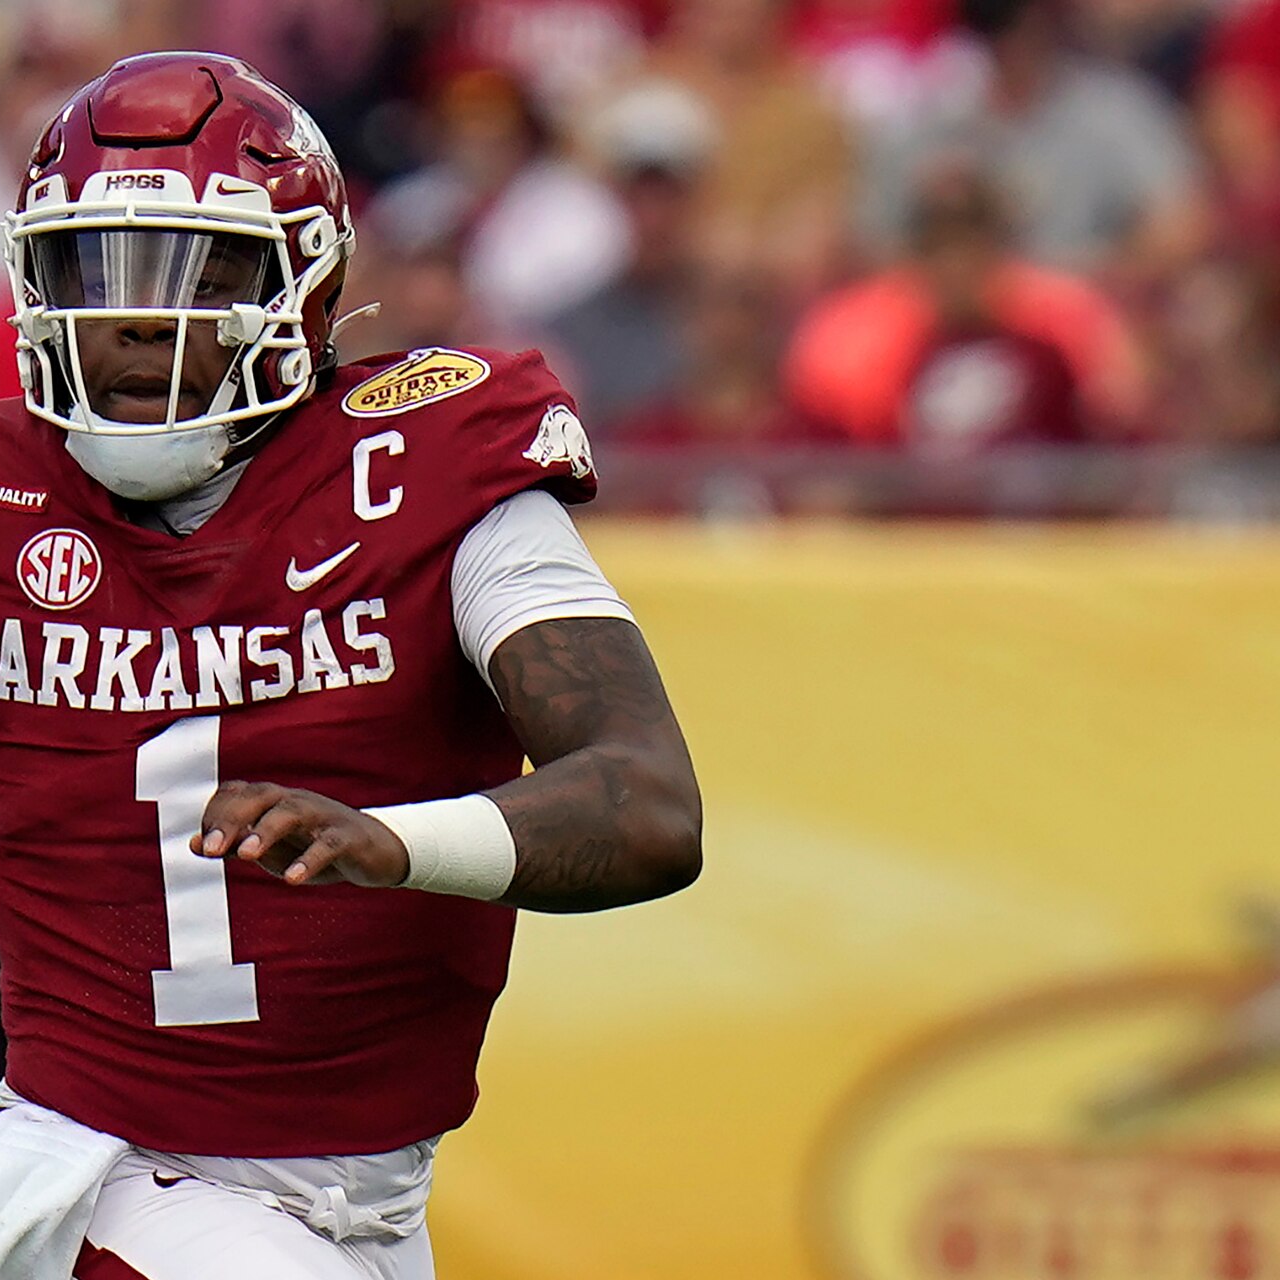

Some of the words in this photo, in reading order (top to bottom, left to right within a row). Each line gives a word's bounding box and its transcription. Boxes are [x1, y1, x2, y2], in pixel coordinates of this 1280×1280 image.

[106, 174, 165, 191] HOGS
[360, 369, 471, 406] OUTBACK
[353, 429, 406, 521] C
[25, 534, 94, 603] SEC
[135, 714, 261, 1028] 1
